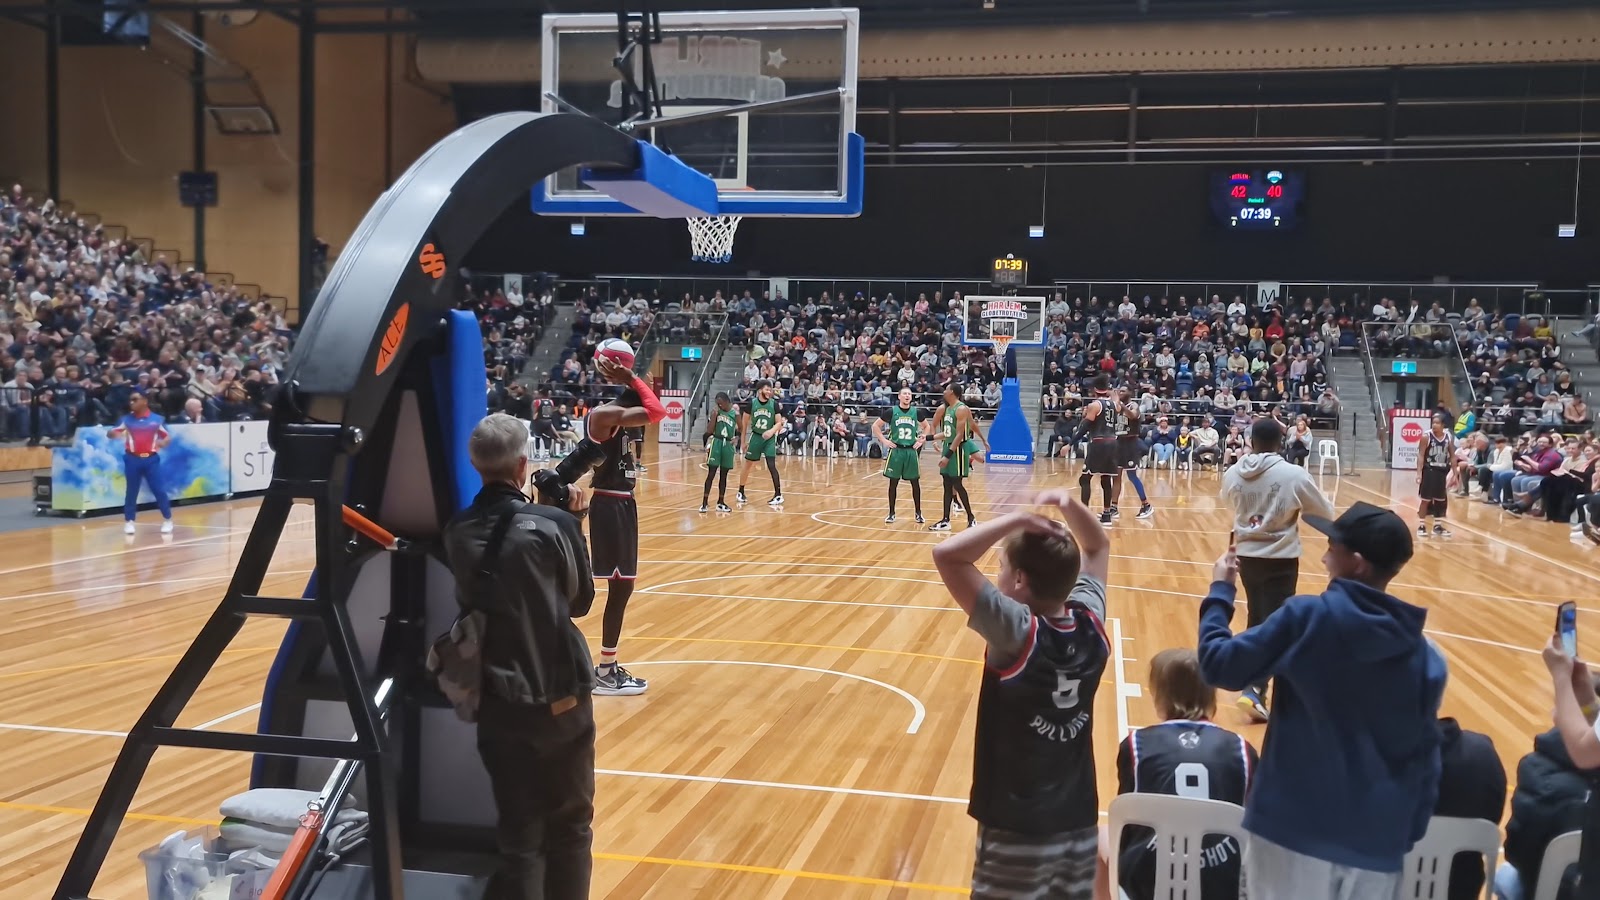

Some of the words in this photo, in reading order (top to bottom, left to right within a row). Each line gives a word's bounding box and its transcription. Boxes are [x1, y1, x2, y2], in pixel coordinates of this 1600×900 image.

[1231, 186, 1246, 197] 42
[1267, 186, 1282, 197] 40
[1241, 208, 1271, 219] 07:39
[995, 260, 1022, 270] 07:39
[1261, 289, 1275, 303] M
[988, 302, 1021, 310] HARLEM
[981, 309, 1027, 319] GLOBETROTTERS
[382, 319, 404, 363] ACE
[755, 418, 768, 429] 42
[721, 426, 728, 438] 4
[898, 428, 912, 440] 32
[244, 452, 273, 477] ST
[1052, 670, 1080, 709] 5
